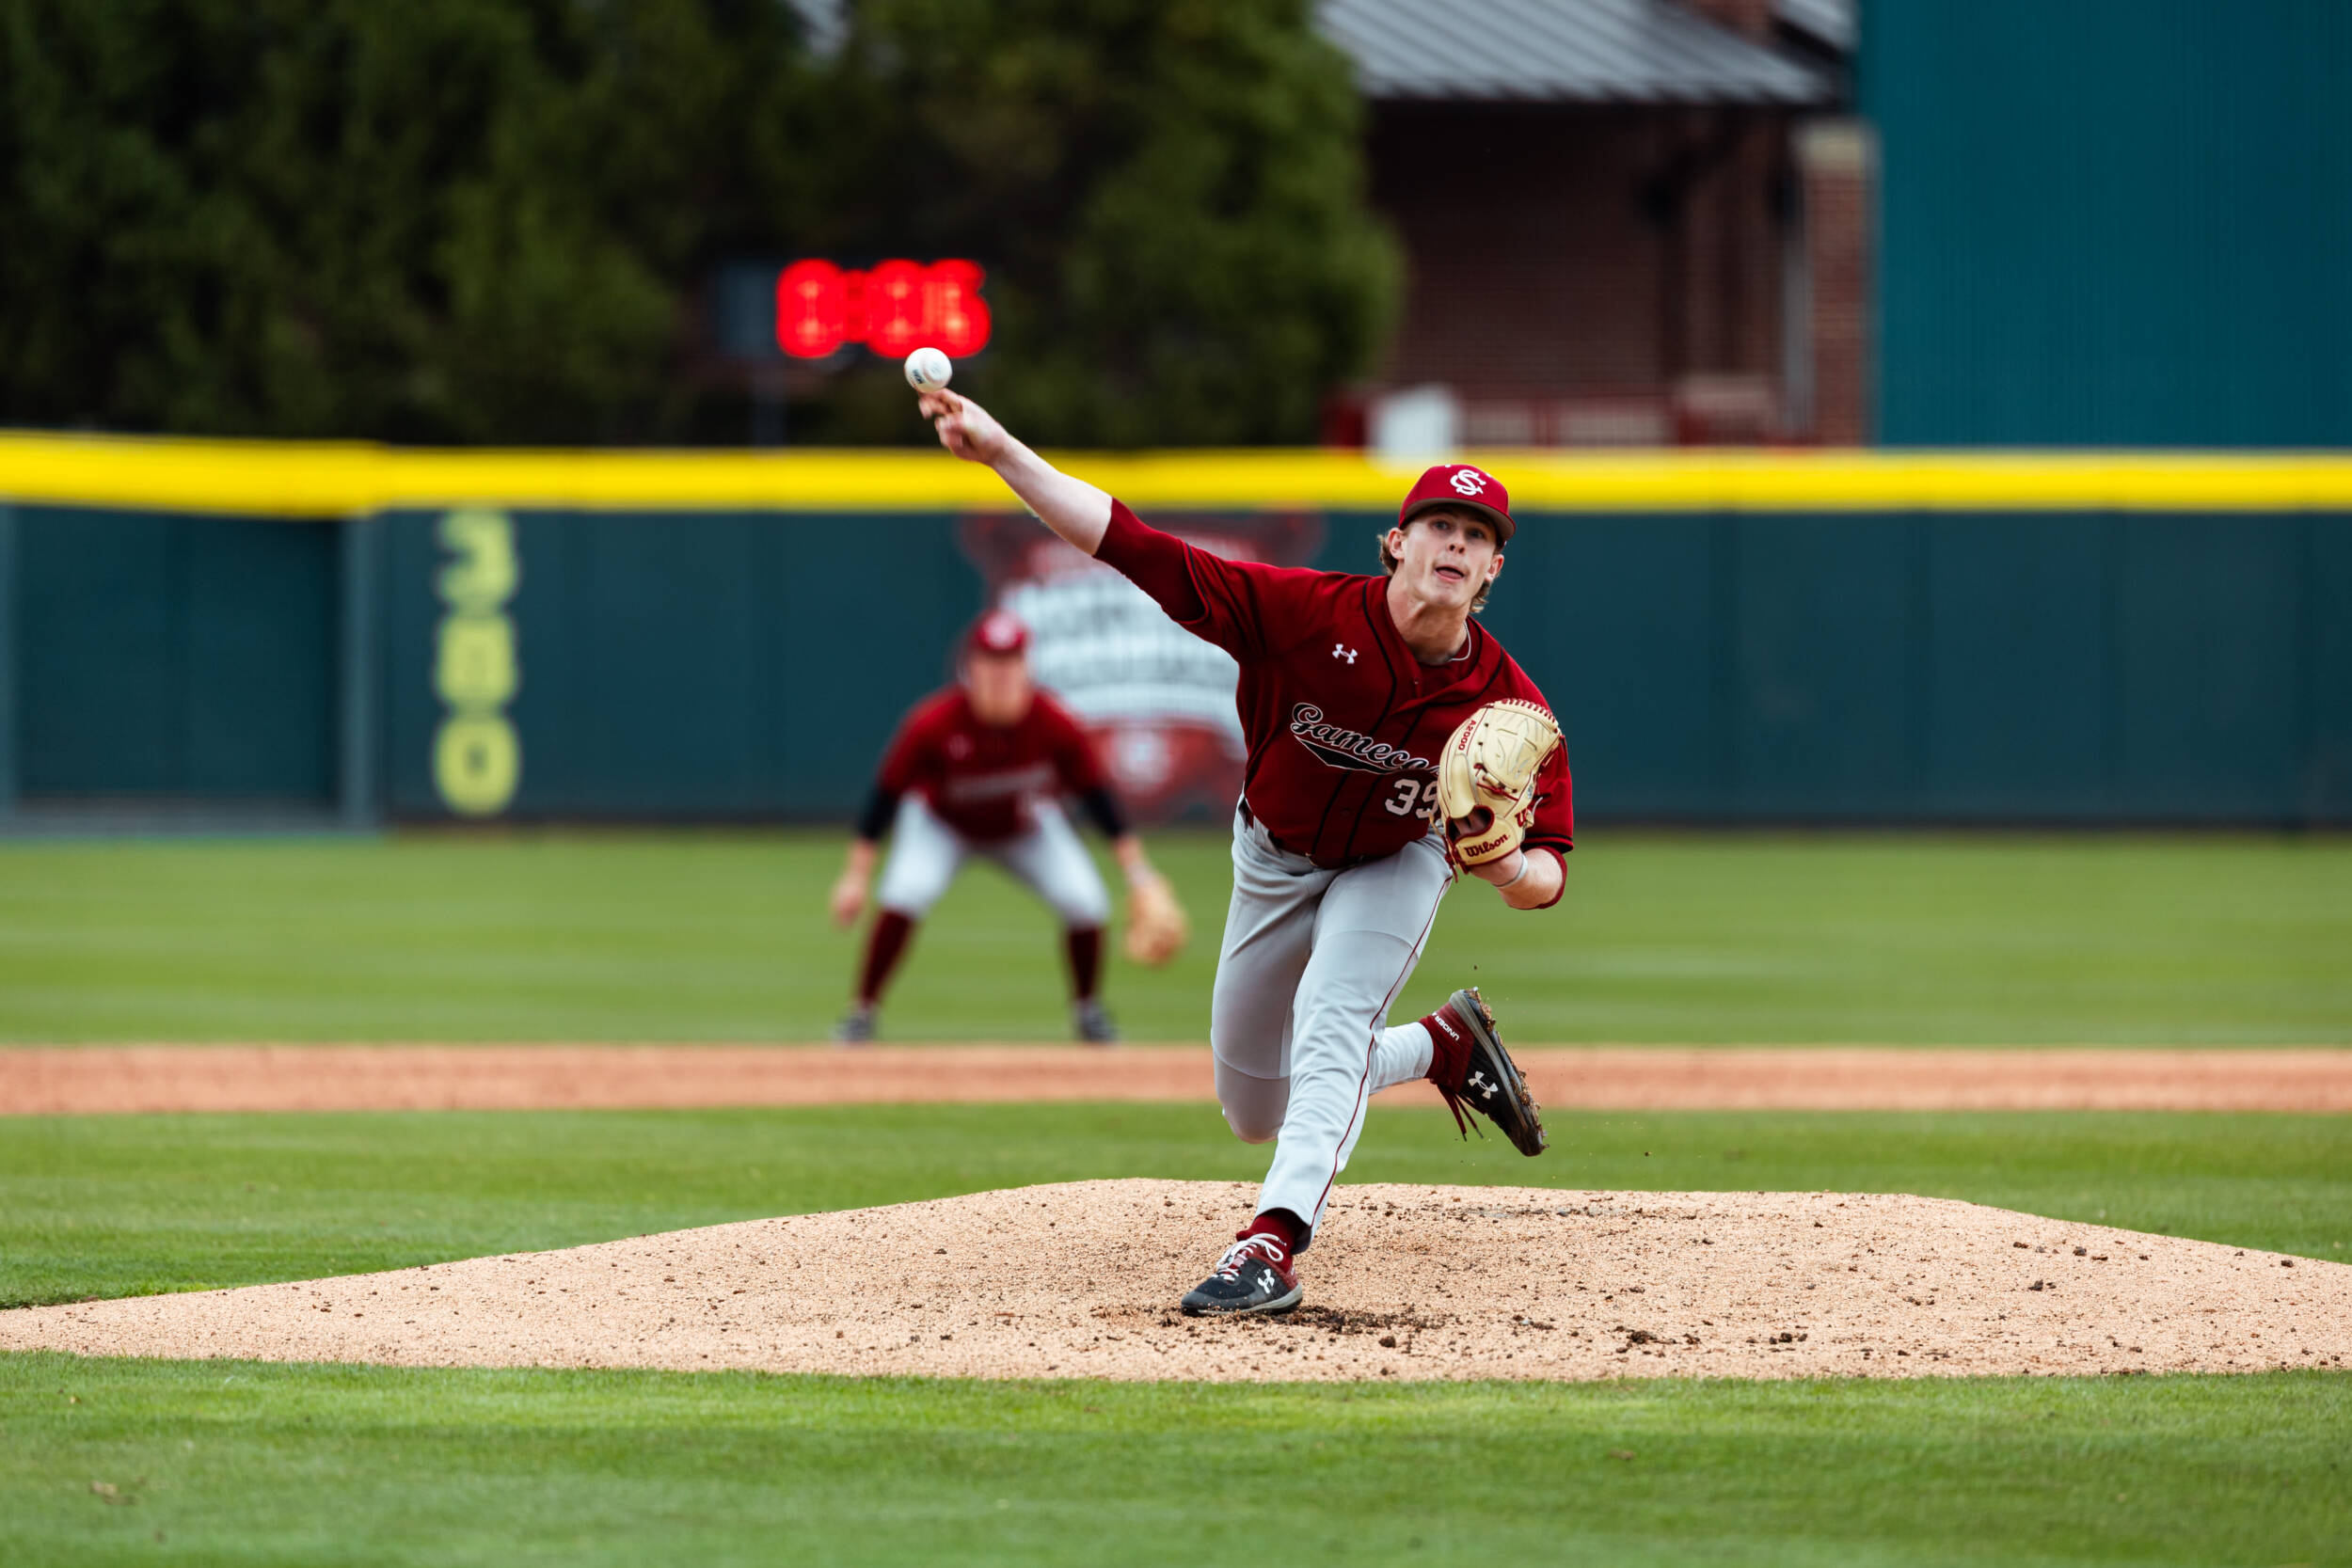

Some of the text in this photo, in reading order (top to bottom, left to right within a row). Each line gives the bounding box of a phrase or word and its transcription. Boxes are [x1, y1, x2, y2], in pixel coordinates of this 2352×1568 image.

[1458, 719, 1477, 751] A2000
[1385, 779, 1439, 818] 39
[1464, 834, 1509, 858] Wilson
[1435, 1015, 1460, 1041] UNDER
